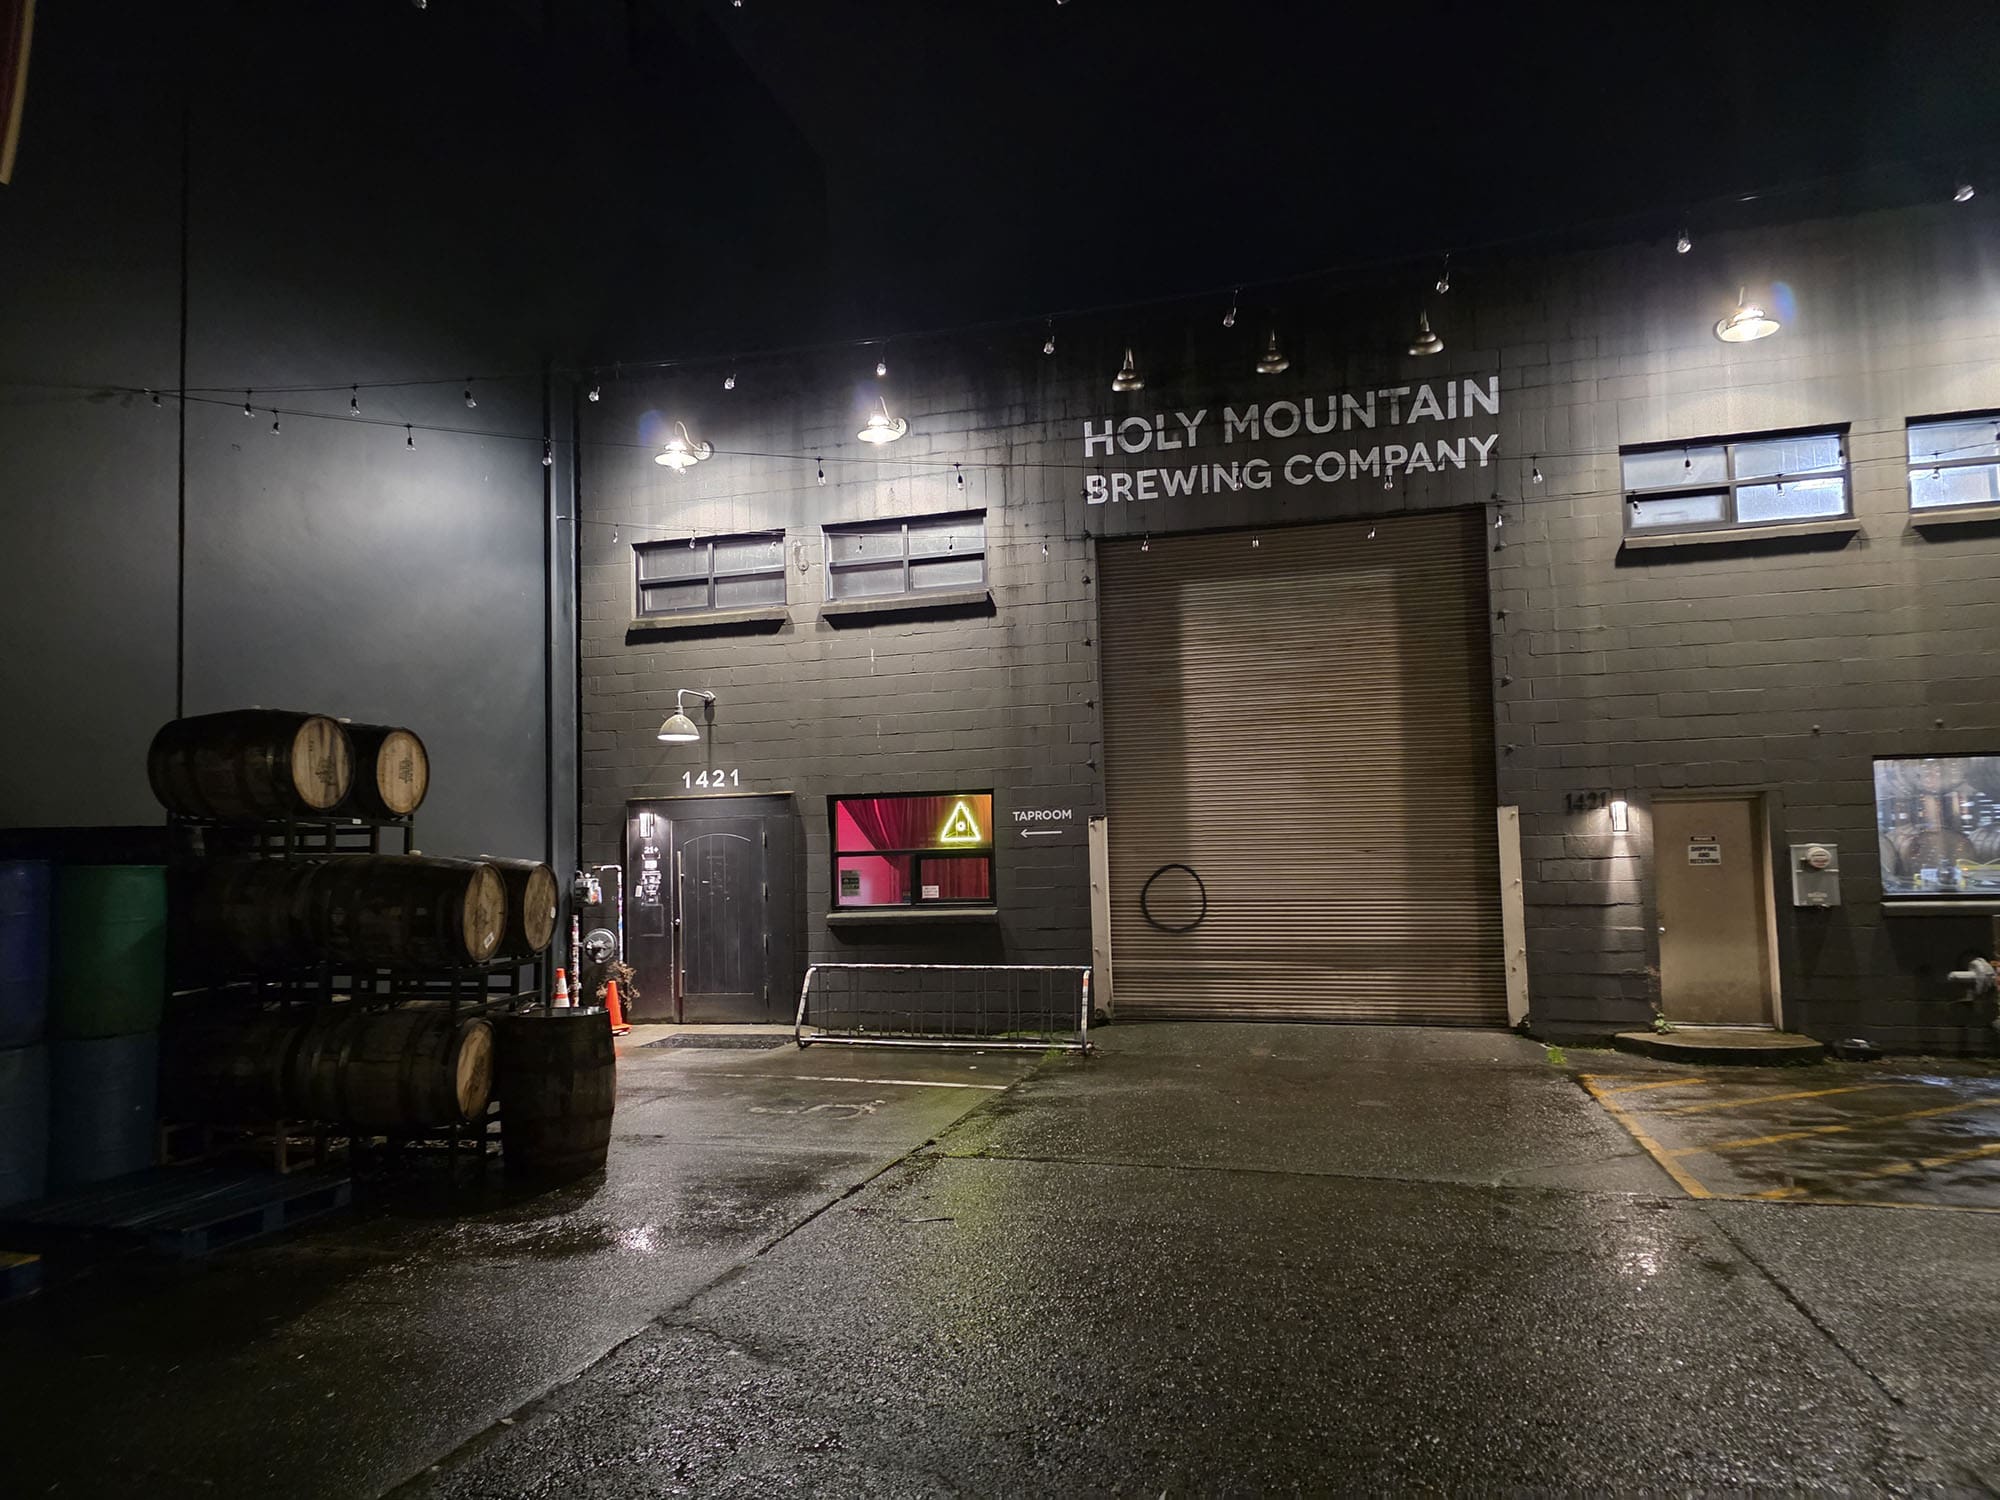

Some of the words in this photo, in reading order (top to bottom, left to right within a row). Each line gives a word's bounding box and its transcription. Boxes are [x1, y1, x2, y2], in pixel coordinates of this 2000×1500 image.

[1084, 410, 1207, 457] HOLY
[1224, 376, 1499, 443] MOUNTAIN
[1086, 459, 1271, 504] BREWING
[1284, 434, 1499, 485] COMPANY
[682, 769, 739, 789] 1421
[1012, 809, 1072, 821] TAPROOM
